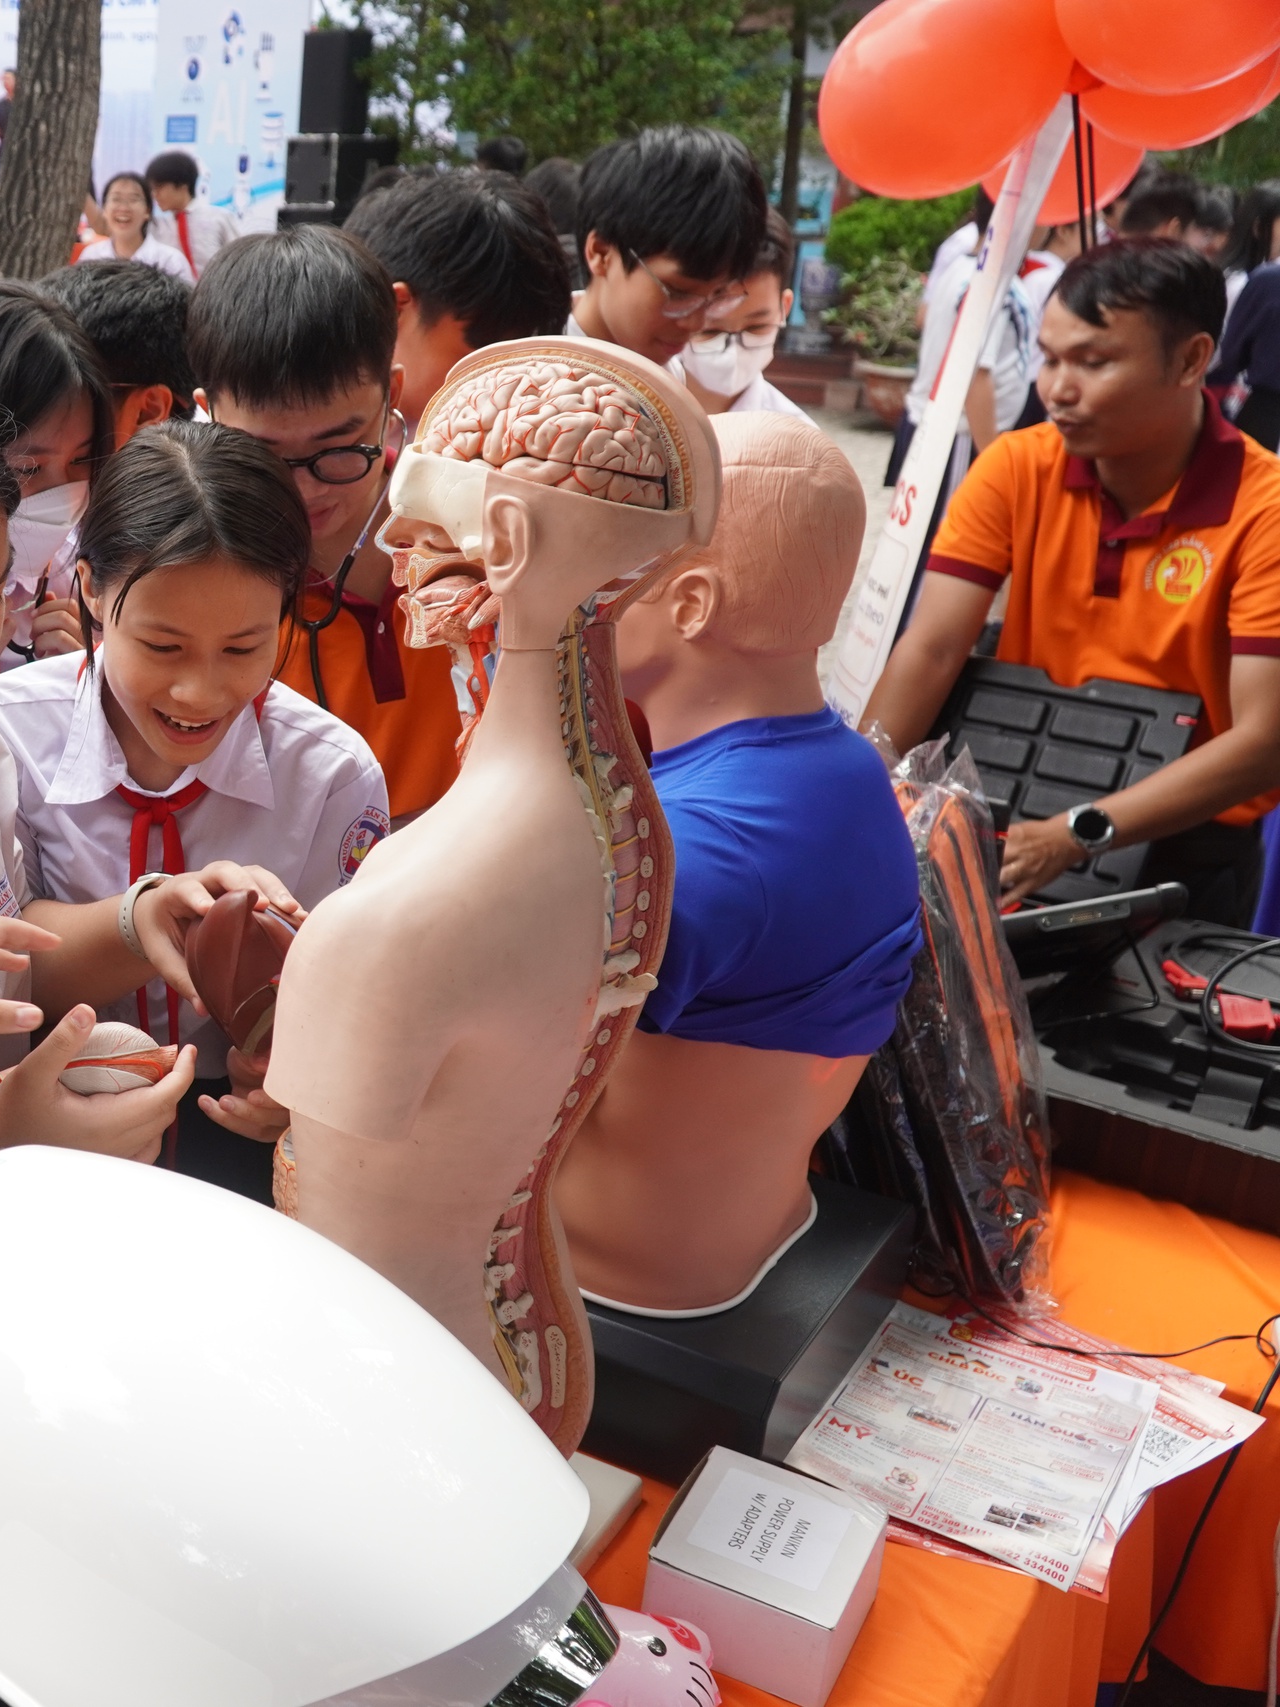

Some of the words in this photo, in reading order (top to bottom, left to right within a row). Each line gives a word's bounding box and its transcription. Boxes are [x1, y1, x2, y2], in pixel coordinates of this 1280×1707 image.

[927, 1351, 970, 1371] CHLB
[893, 1368, 924, 1387] ÚC
[828, 1416, 872, 1440] MỸ
[768, 1497, 795, 1531] POWER
[917, 1516, 944, 1529] 0977
[920, 1509, 940, 1521] 028
[727, 1504, 763, 1550] ADAPTERS
[780, 1518, 812, 1559] MANIKIN
[749, 1529, 778, 1564] SUPPLY
[1023, 1557, 1066, 1583] 334400
